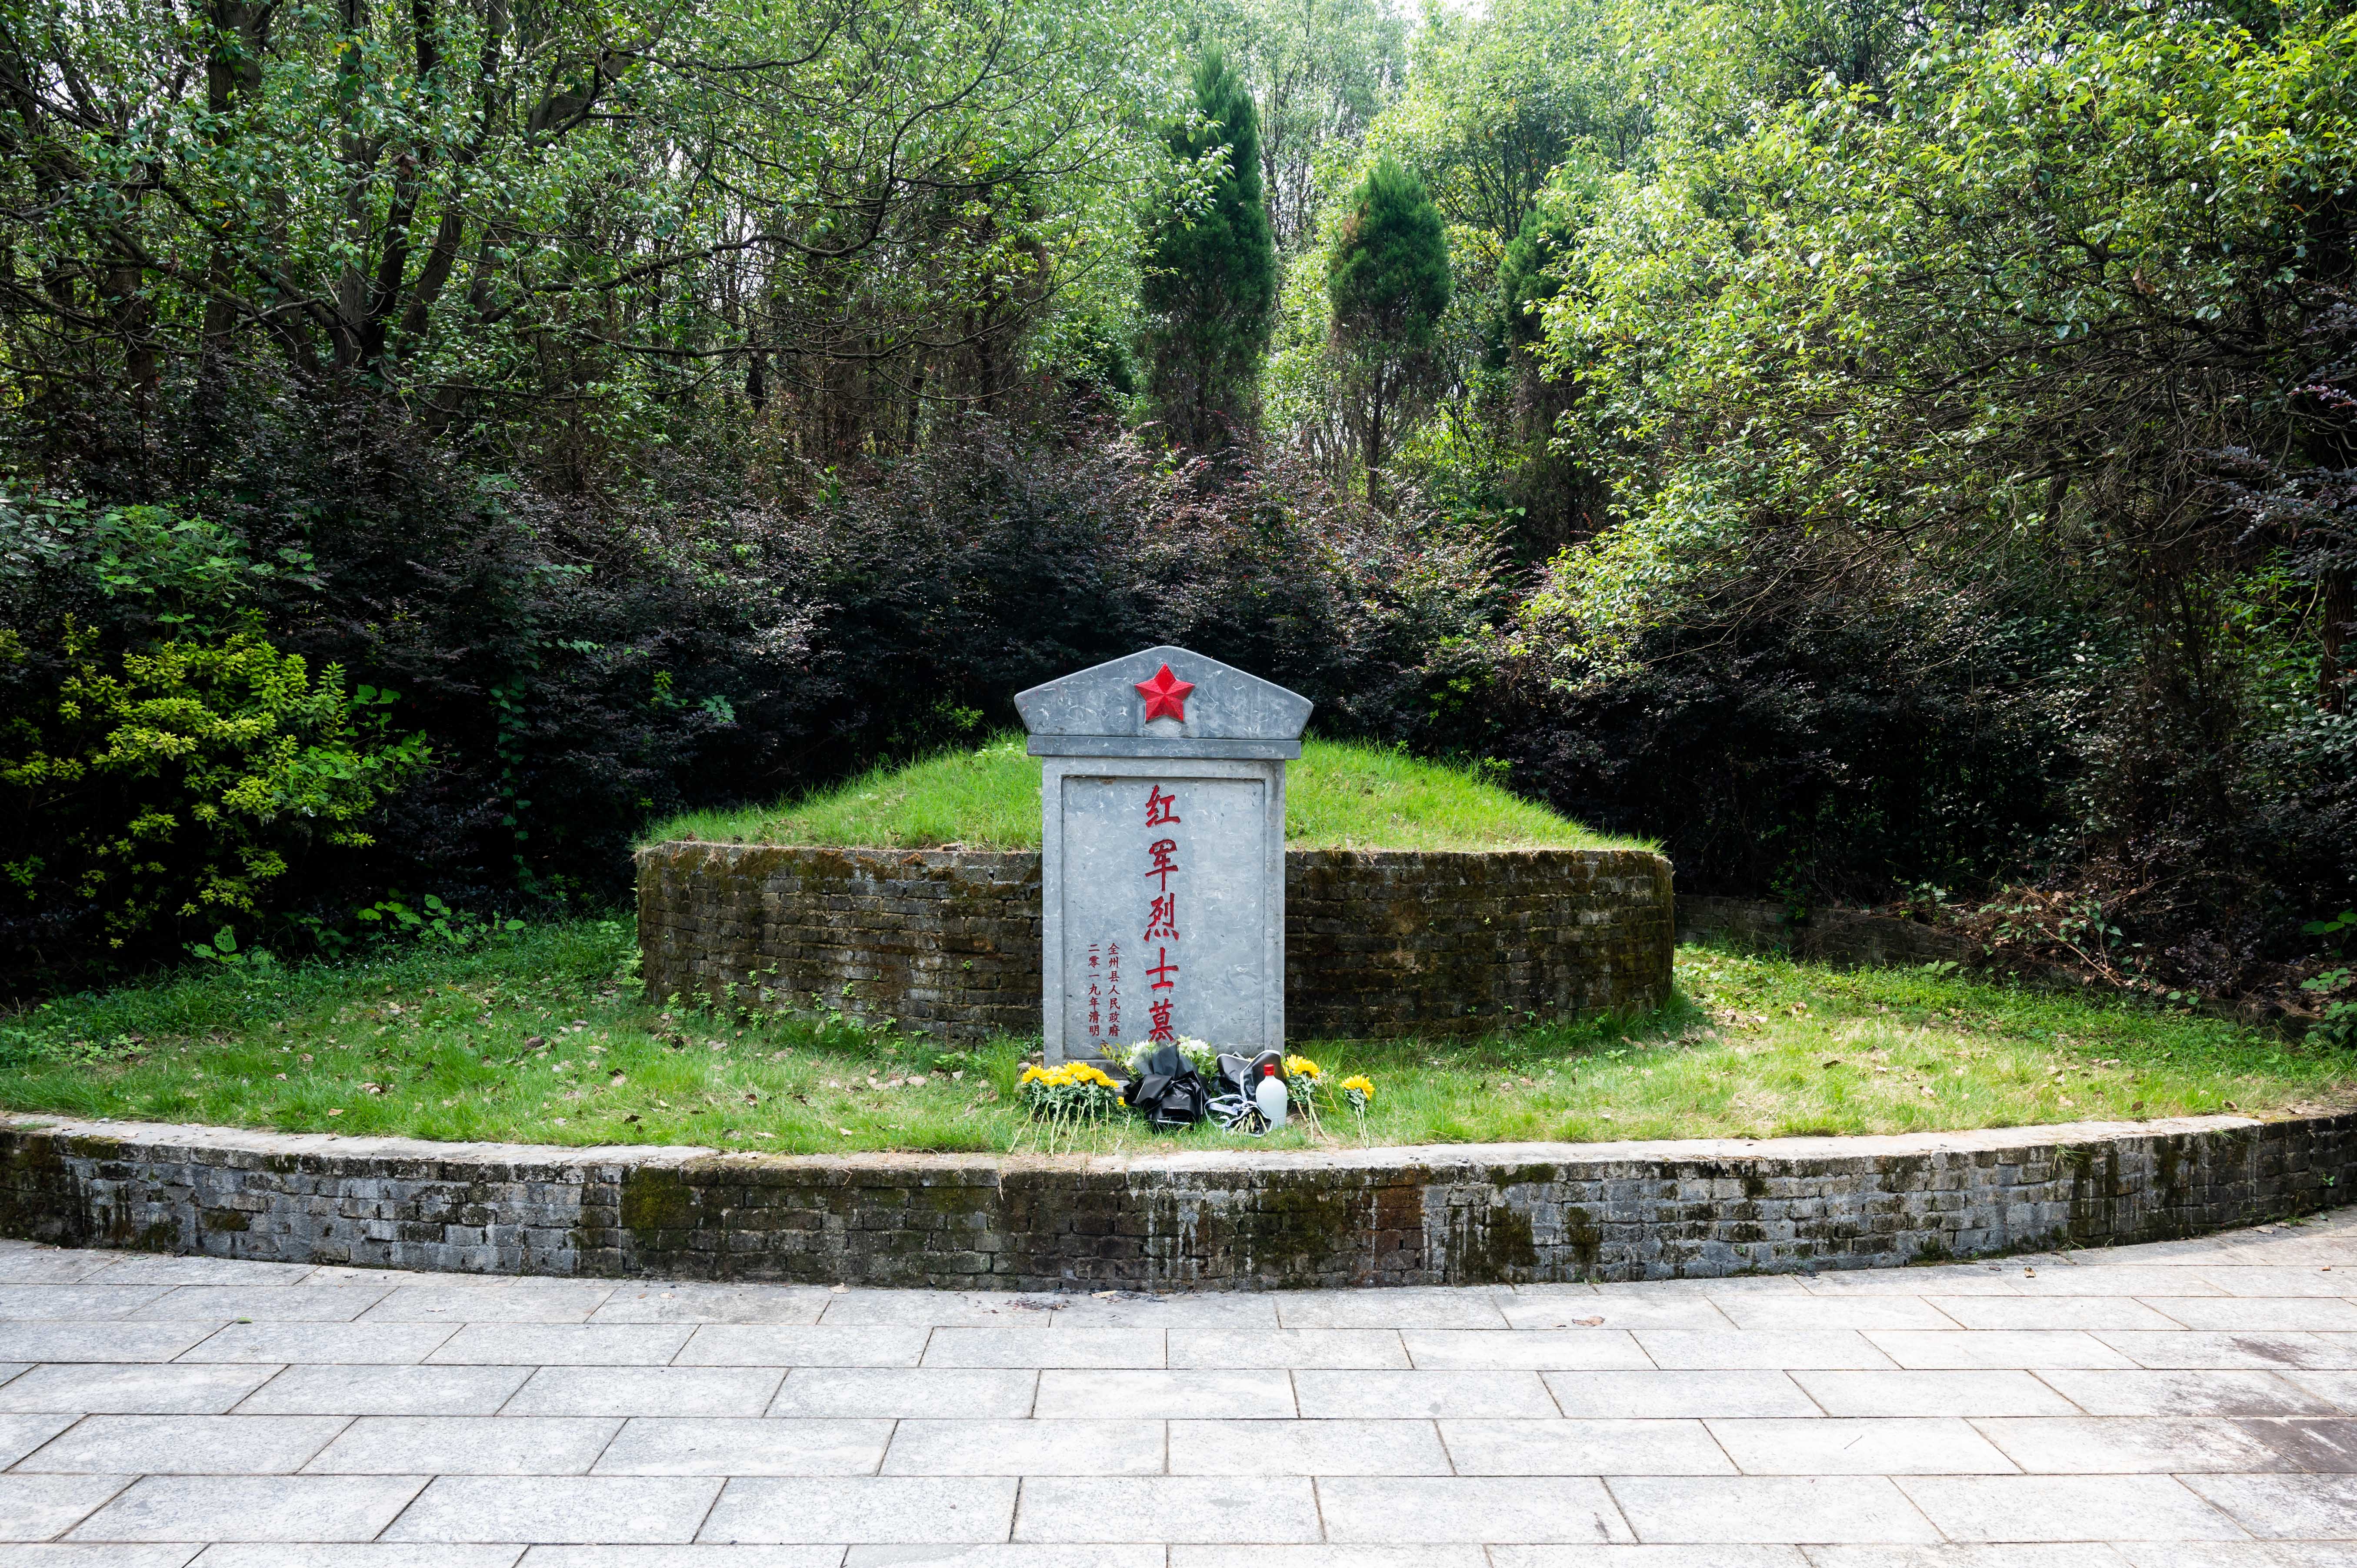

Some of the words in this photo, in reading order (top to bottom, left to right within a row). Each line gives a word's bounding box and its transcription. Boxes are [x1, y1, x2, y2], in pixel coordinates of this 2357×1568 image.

[1144, 785, 1180, 1044] 红军烈士墓
[1088, 944, 1101, 1037] 二零一九年清明
[1108, 942, 1120, 1037] 全州县人民政府
